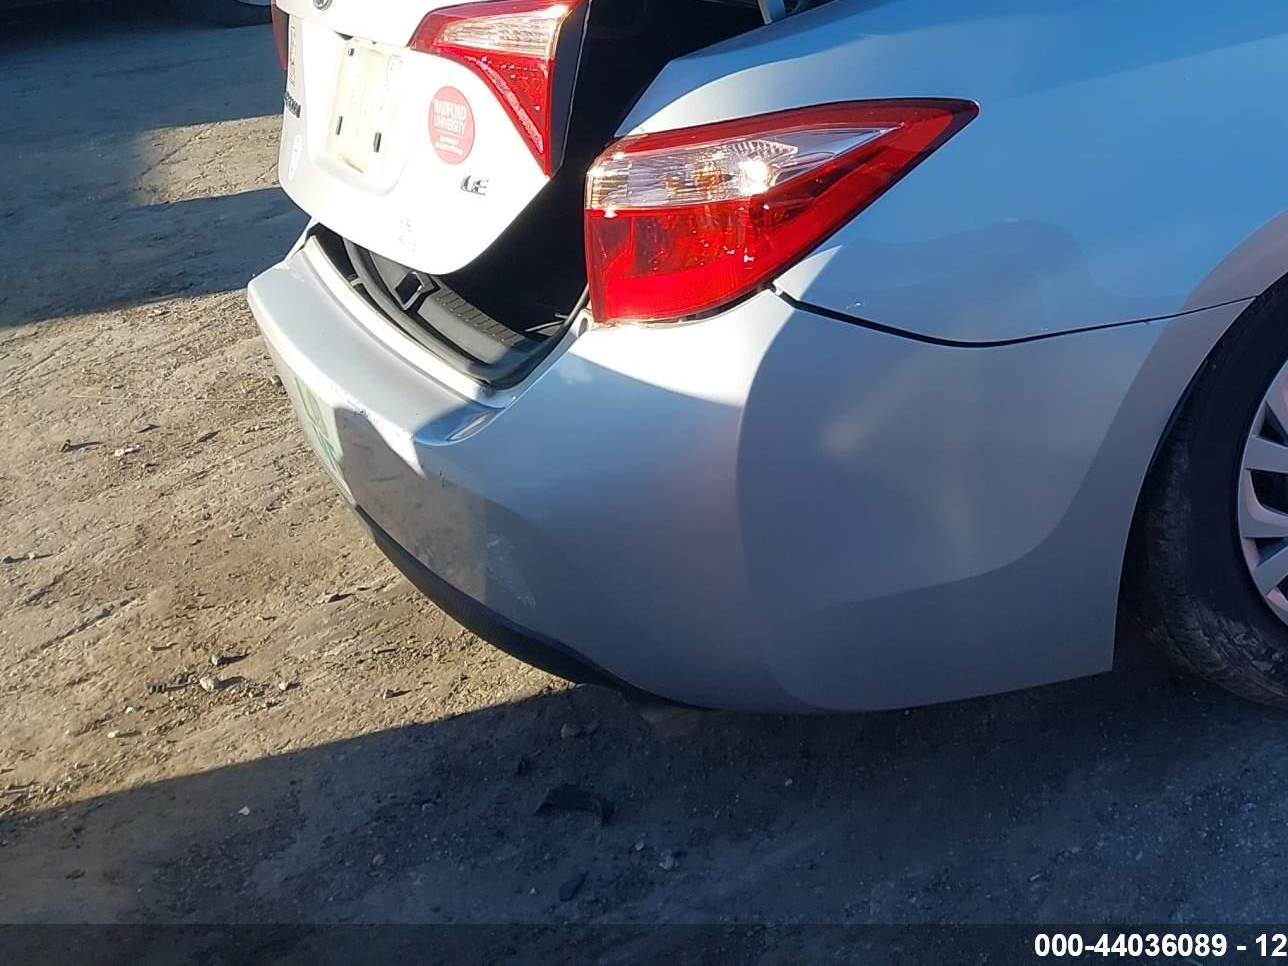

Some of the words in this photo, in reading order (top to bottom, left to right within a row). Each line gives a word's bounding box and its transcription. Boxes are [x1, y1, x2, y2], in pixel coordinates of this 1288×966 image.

[434, 99, 467, 121] RADFORD
[433, 114, 466, 138] UNIVERSITY
[460, 175, 489, 196] LE
